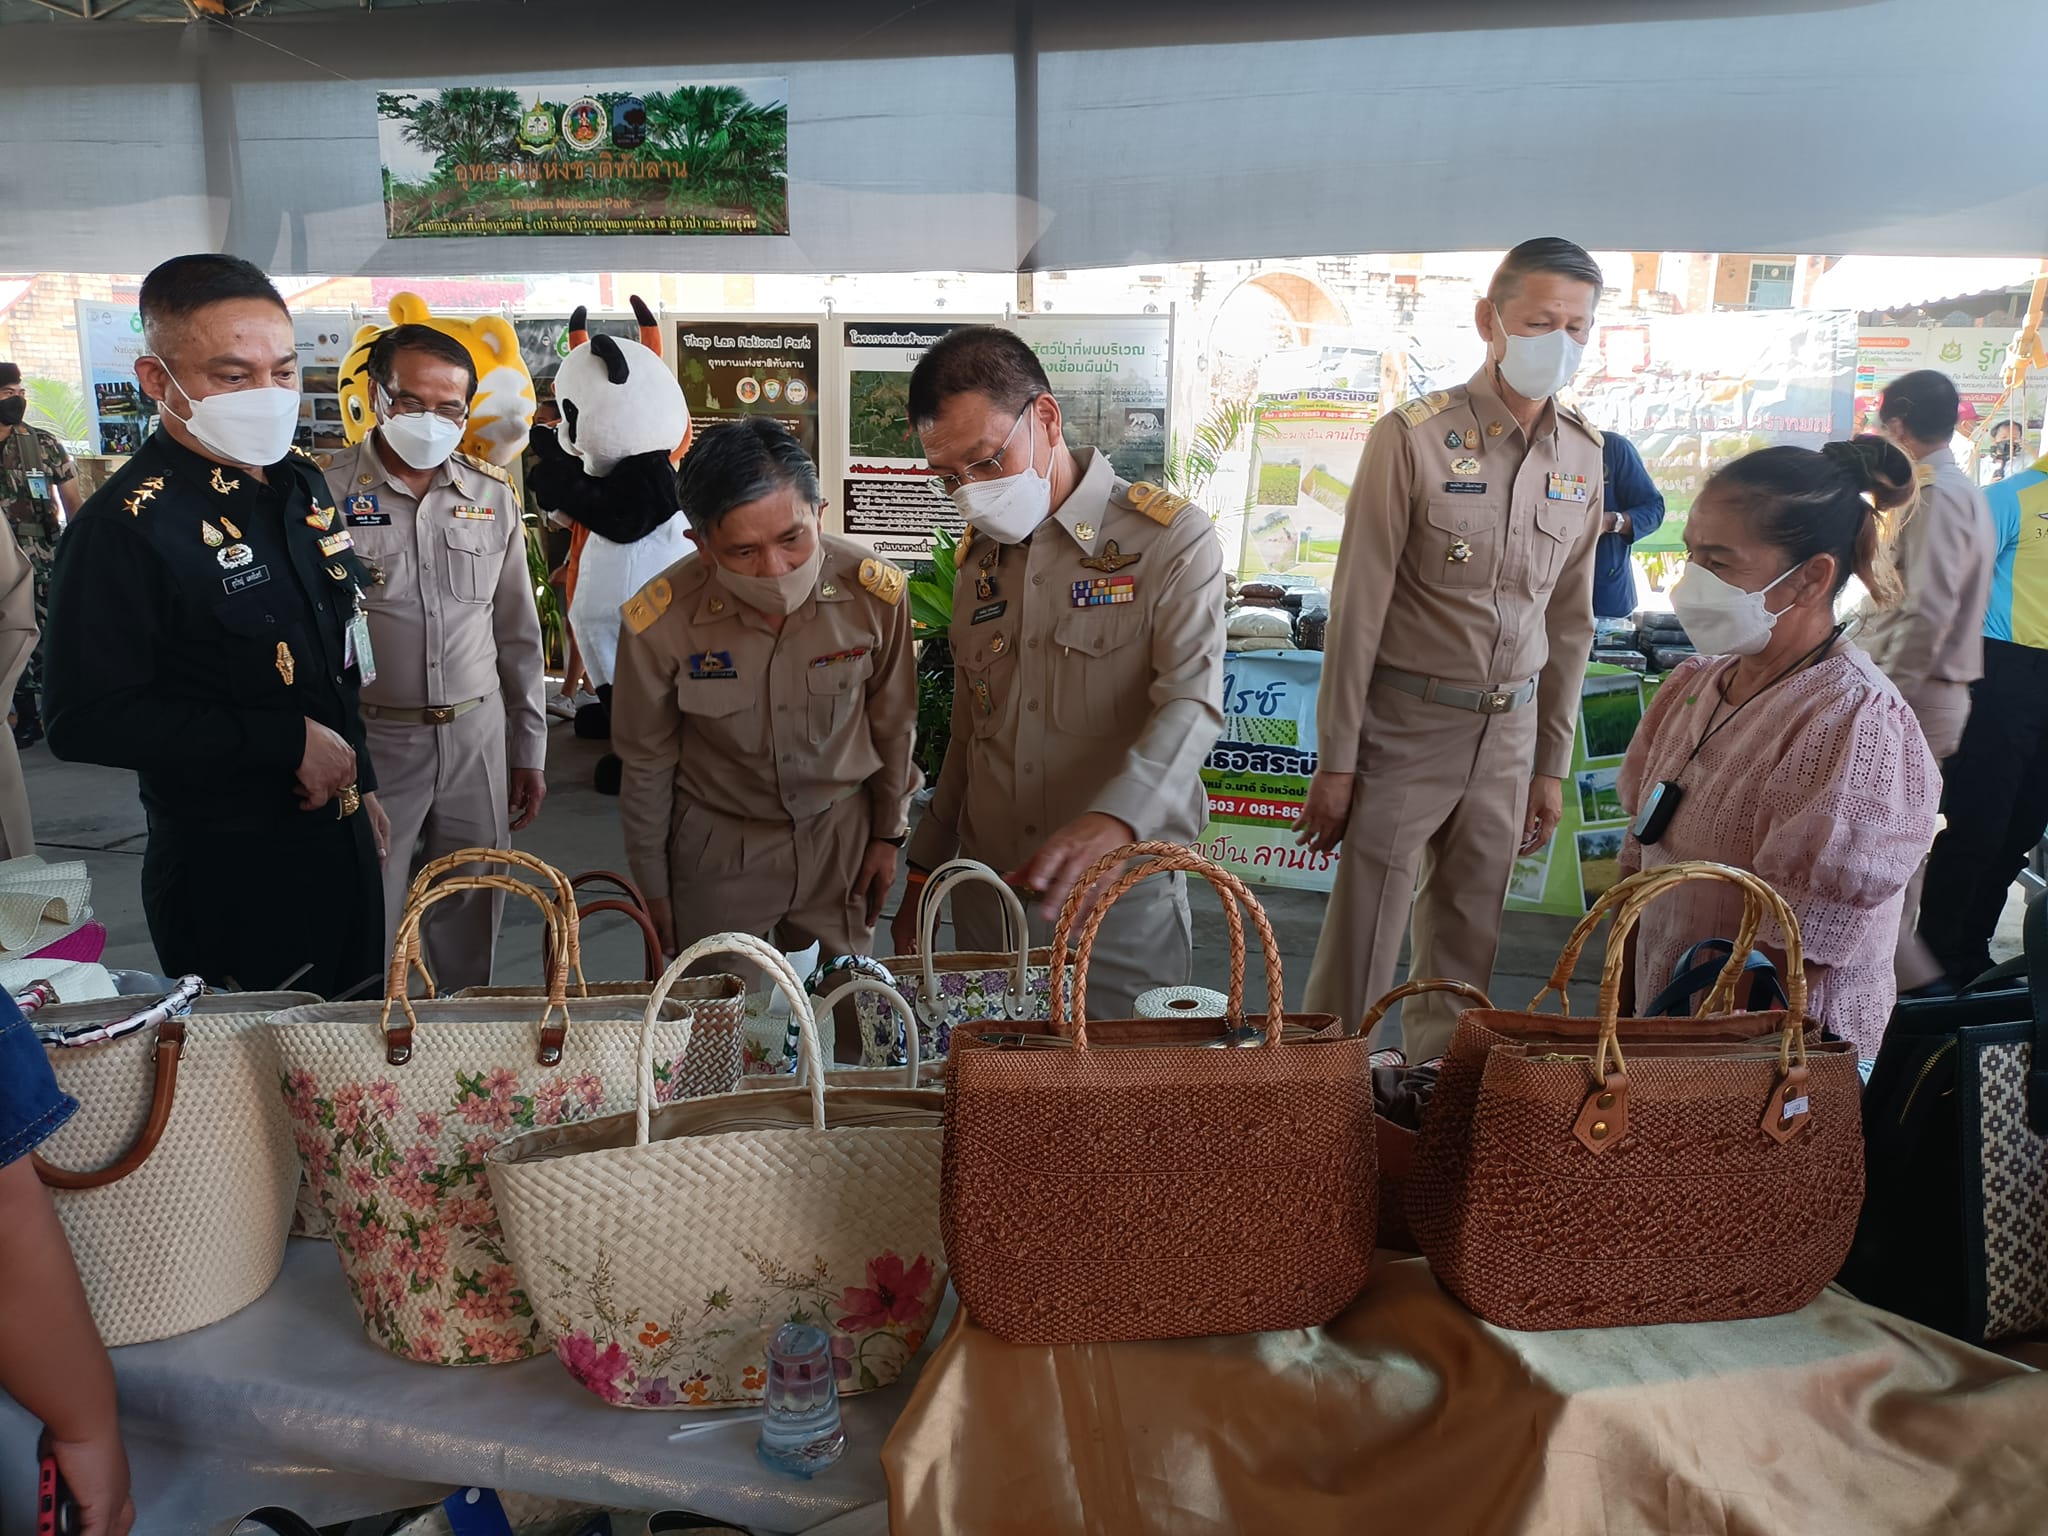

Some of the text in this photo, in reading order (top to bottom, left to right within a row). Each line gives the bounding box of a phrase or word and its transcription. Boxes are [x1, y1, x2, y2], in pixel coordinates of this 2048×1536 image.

[454, 150, 689, 191] อุทยานแห่งชาติทับลาน
[511, 197, 631, 212] Thaplan National Park
[583, 210, 667, 232] กรมอุทยานแห่งชาติ
[669, 215, 700, 229] สัตว์ป่า
[703, 214, 757, 232] และพันธุ์พืช
[684, 334, 811, 350] Thap Lan National Park
[708, 356, 804, 370] อุทยานแห่งชาติทับลาน
[1225, 782, 1257, 793] อ.นาดี
[1260, 783, 1308, 797] จังหวัดป
[1249, 803, 1304, 818] 081-86
